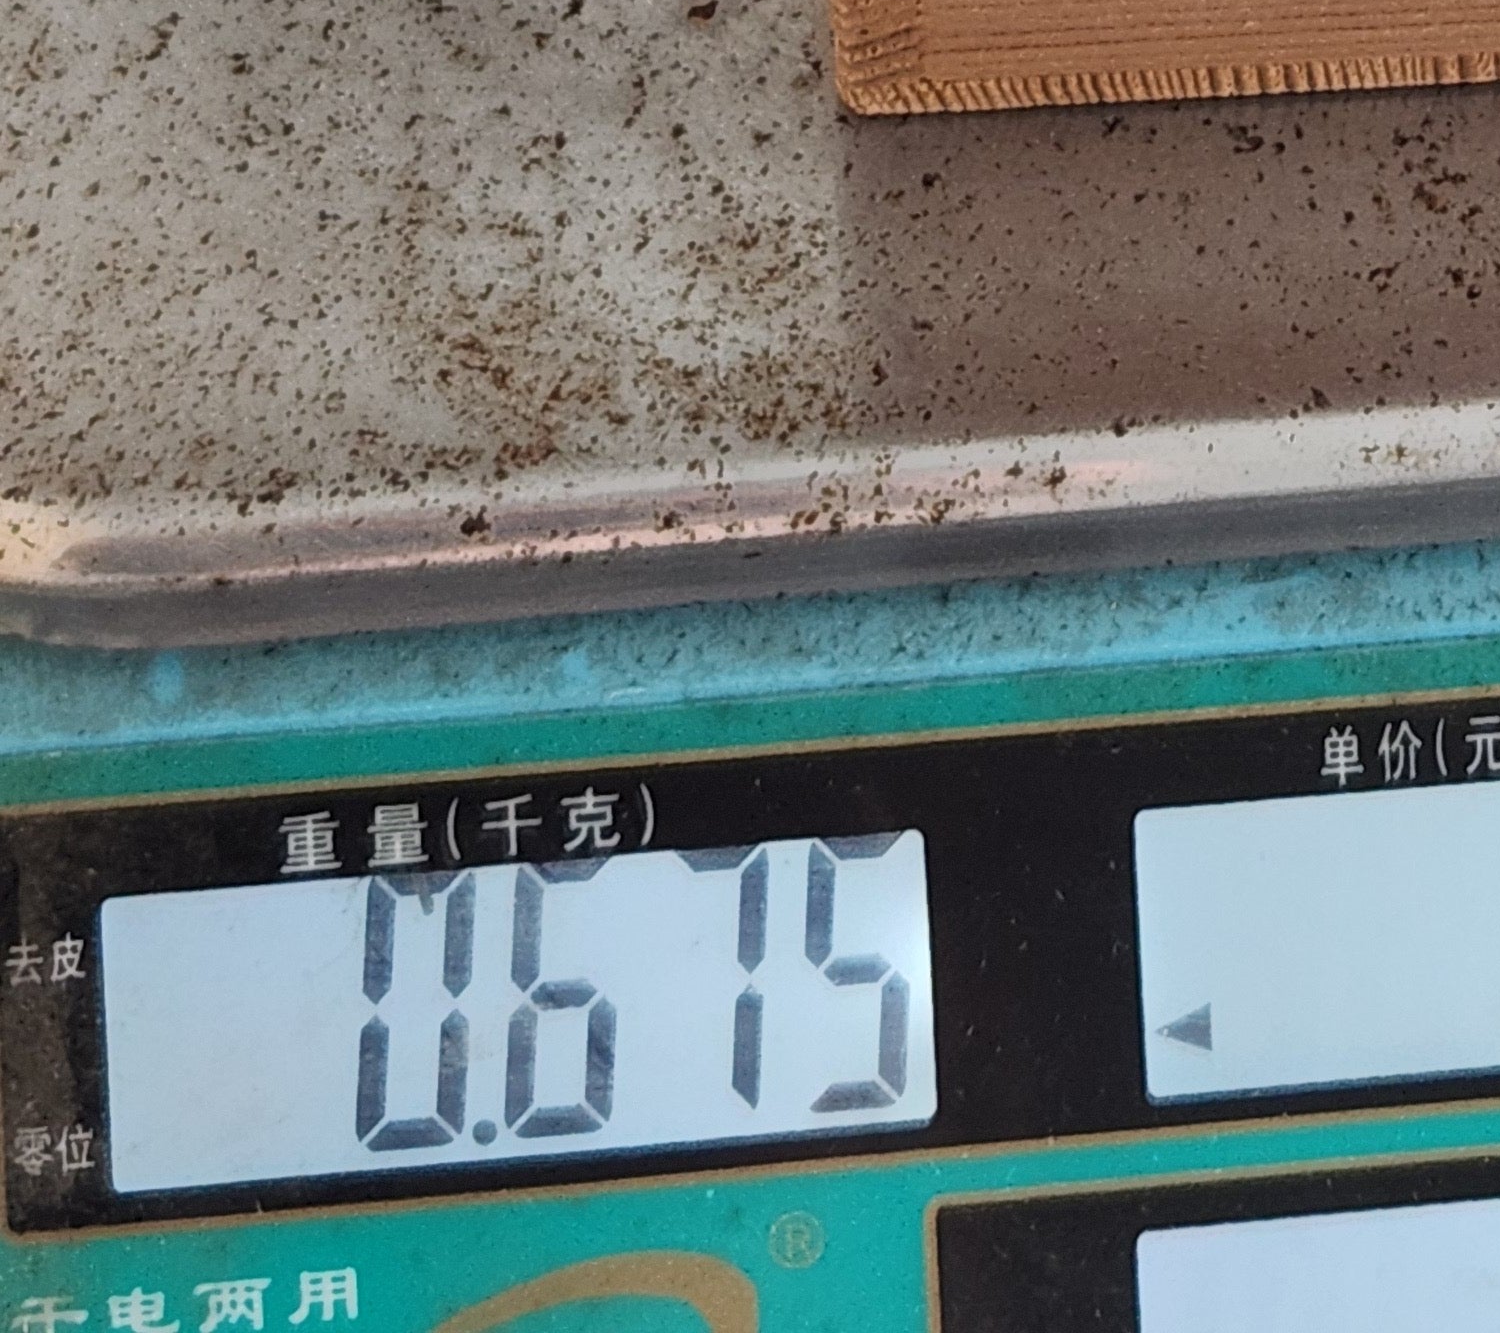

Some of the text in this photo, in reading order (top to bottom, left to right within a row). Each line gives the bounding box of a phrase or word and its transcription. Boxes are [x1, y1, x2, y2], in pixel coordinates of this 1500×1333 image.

[279, 783, 655, 874] 重量(千克)
[5, 931, 86, 985] 去皮
[355, 830, 909, 1152] 0.675
[14, 1124, 95, 1176] 零位
